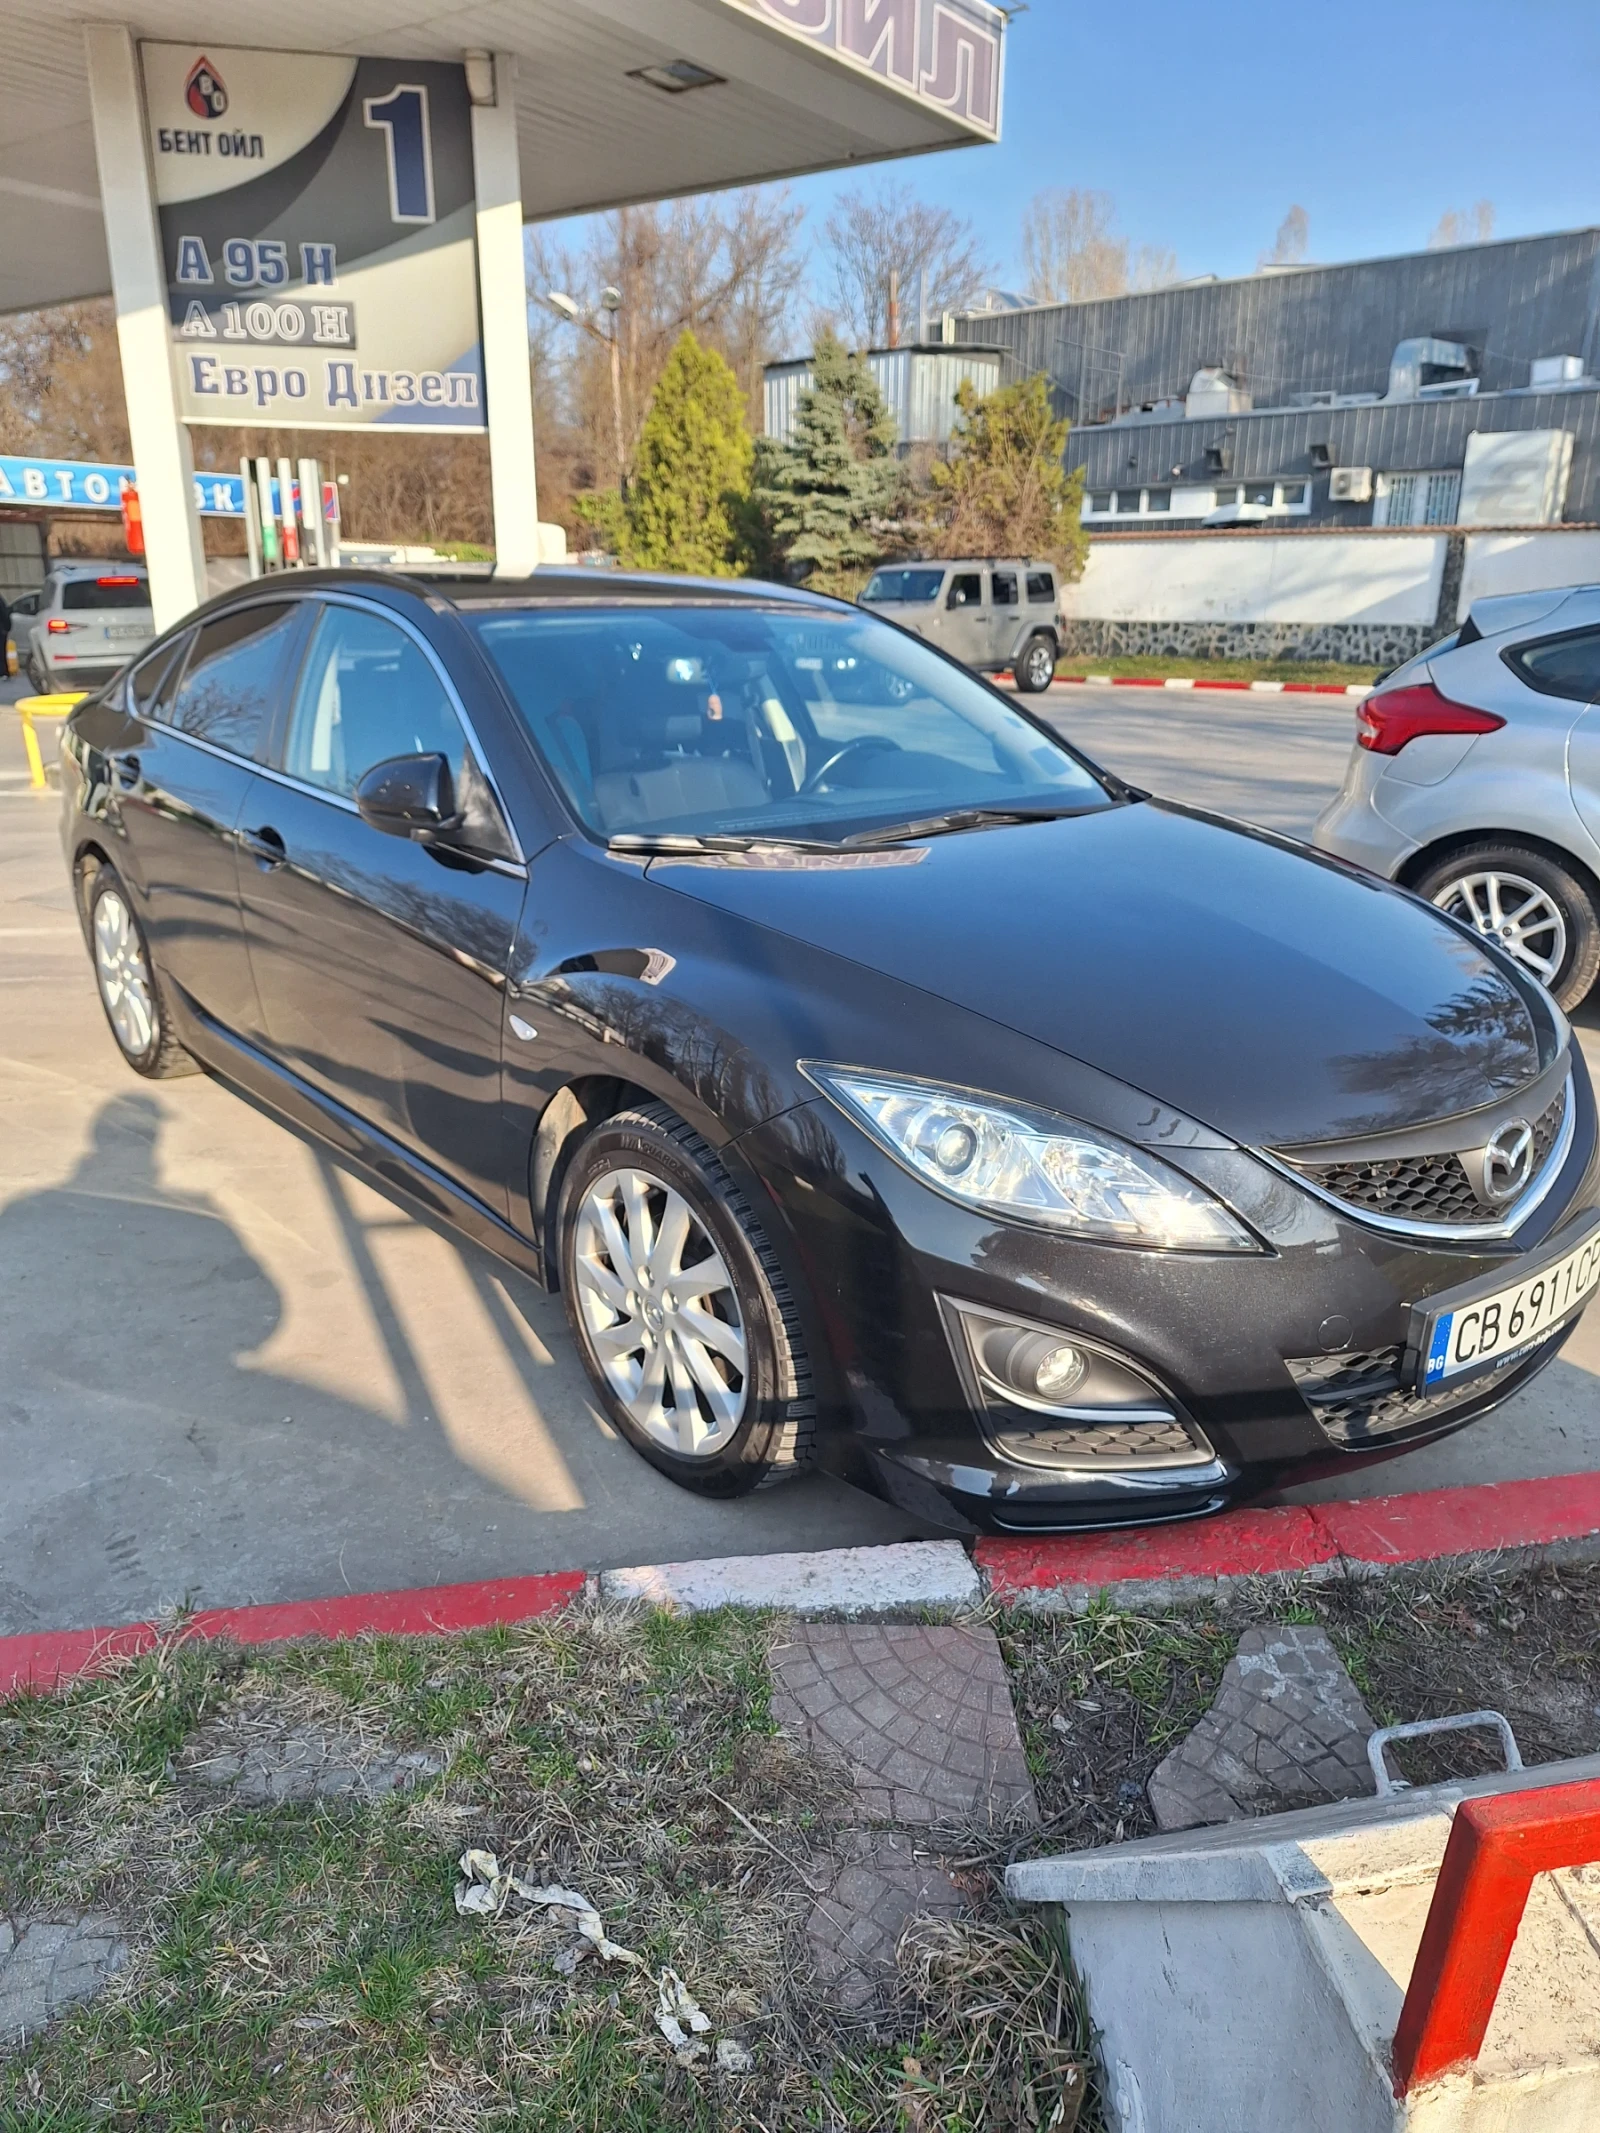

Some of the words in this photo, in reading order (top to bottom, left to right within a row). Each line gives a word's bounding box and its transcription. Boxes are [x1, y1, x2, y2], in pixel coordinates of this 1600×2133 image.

[158, 128, 212, 155] БЕНТ
[218, 128, 264, 159] ОЙЛ
[363, 84, 436, 224] 1
[223, 239, 289, 288] 95
[221, 302, 306, 340] 100
[189, 354, 310, 409] Евро
[324, 359, 479, 411] Дизел
[1455, 1303, 1501, 1363] CB
[1508, 1260, 1574, 1339] 6911
[1427, 1355, 1445, 1374] BG
